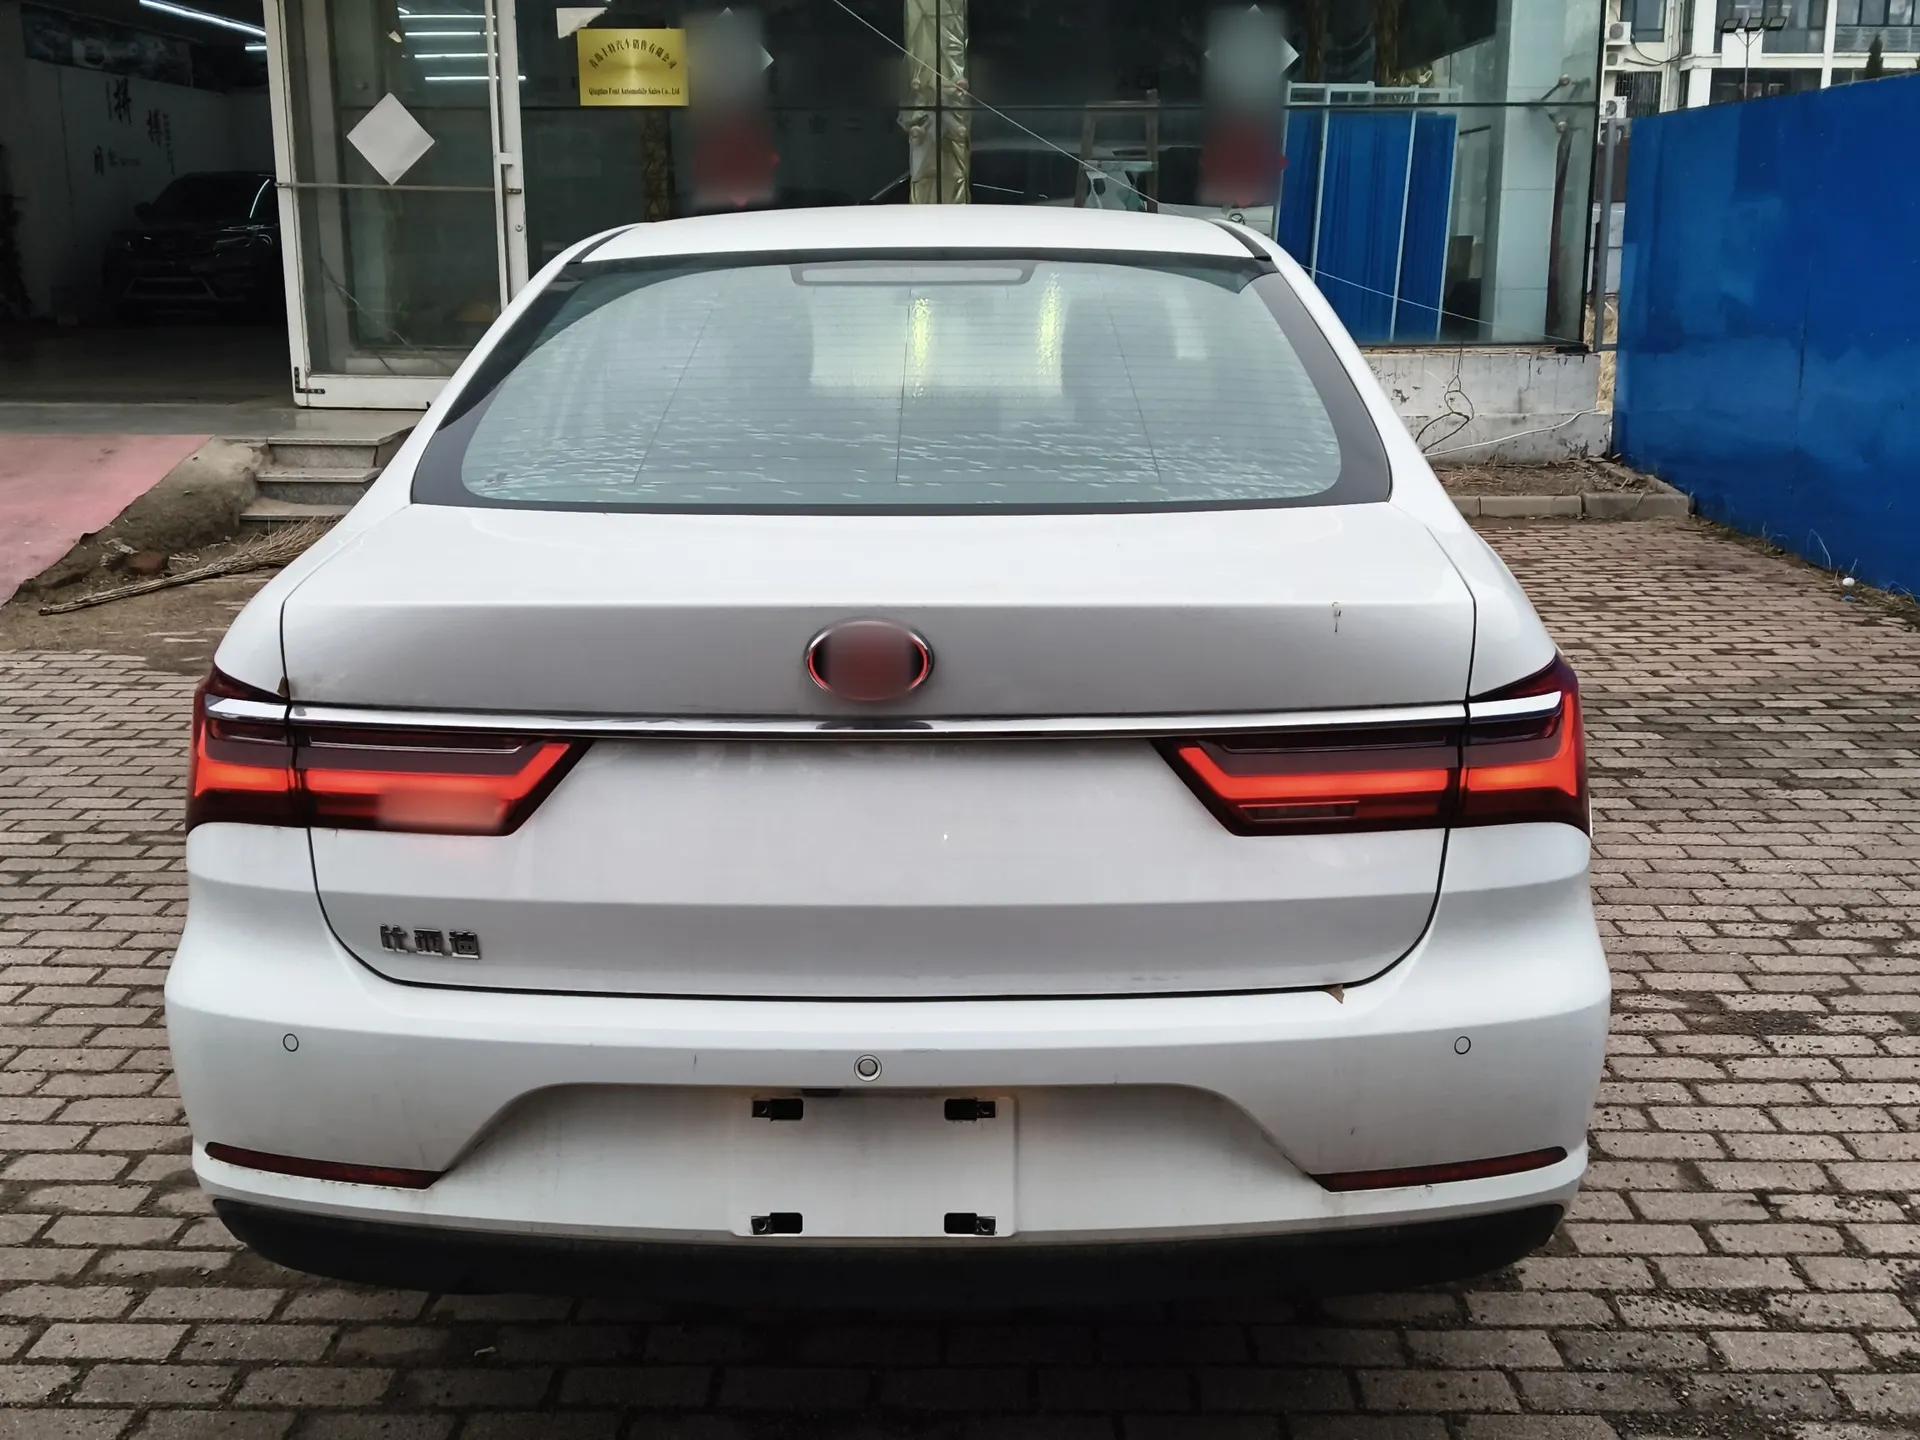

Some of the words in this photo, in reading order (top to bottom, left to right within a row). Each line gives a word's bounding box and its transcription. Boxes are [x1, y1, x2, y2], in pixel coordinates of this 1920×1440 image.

[588, 87, 608, 97] Qingdao
[621, 87, 647, 96] Automobile
[648, 87, 661, 96] Sales
[379, 924, 481, 960] 比亚迪
